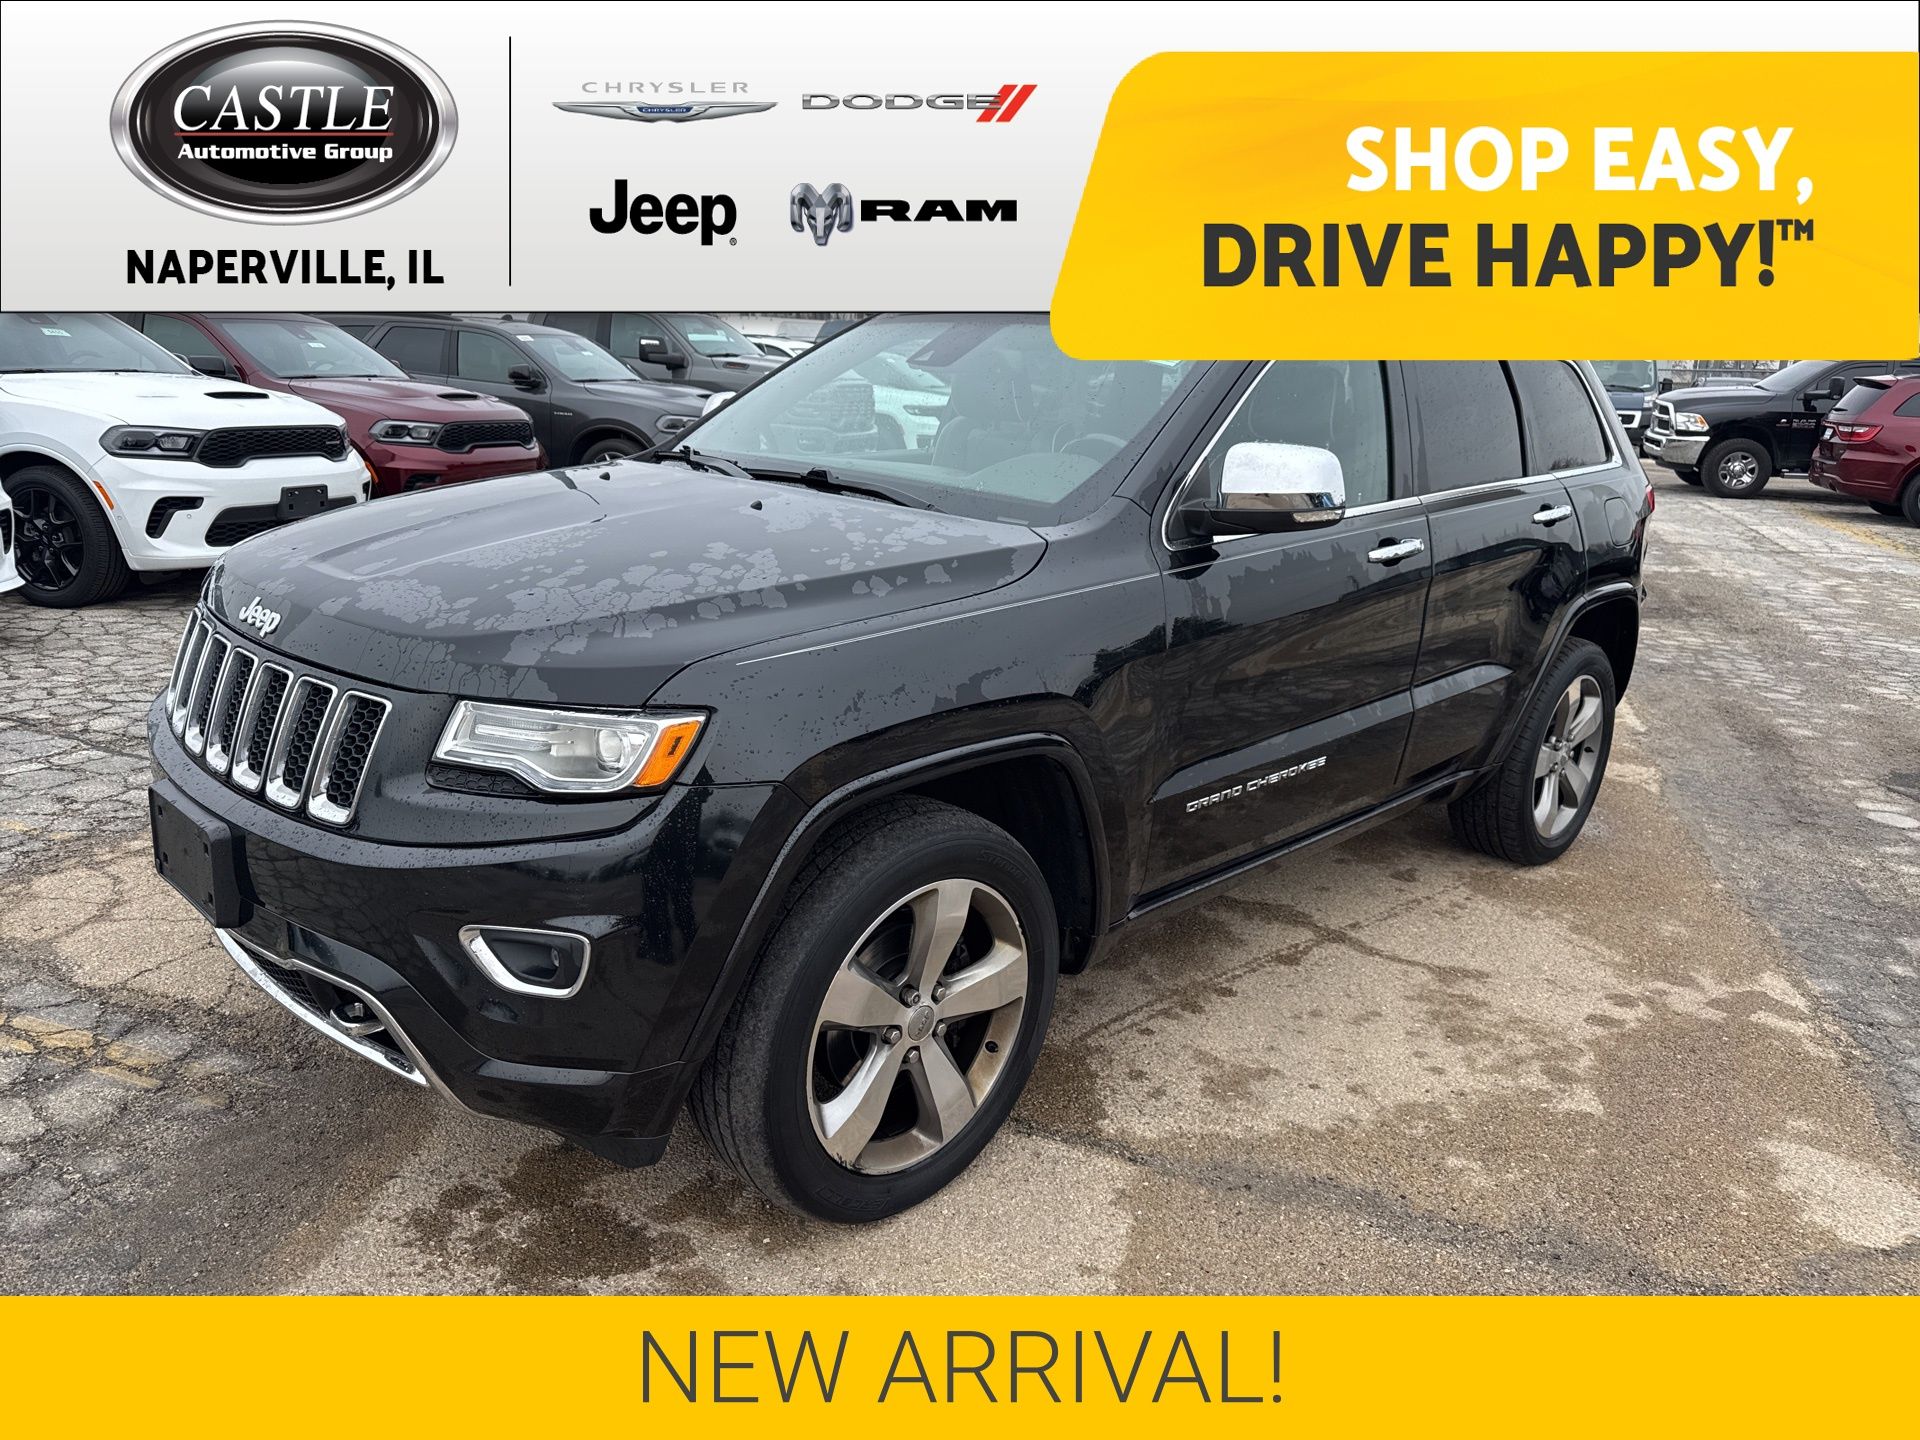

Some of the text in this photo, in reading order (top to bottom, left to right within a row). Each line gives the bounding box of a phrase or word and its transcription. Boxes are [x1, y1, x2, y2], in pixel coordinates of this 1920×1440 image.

[239, 596, 281, 638] Jeep
[1186, 756, 1327, 813] GRAND CHEROKEE
